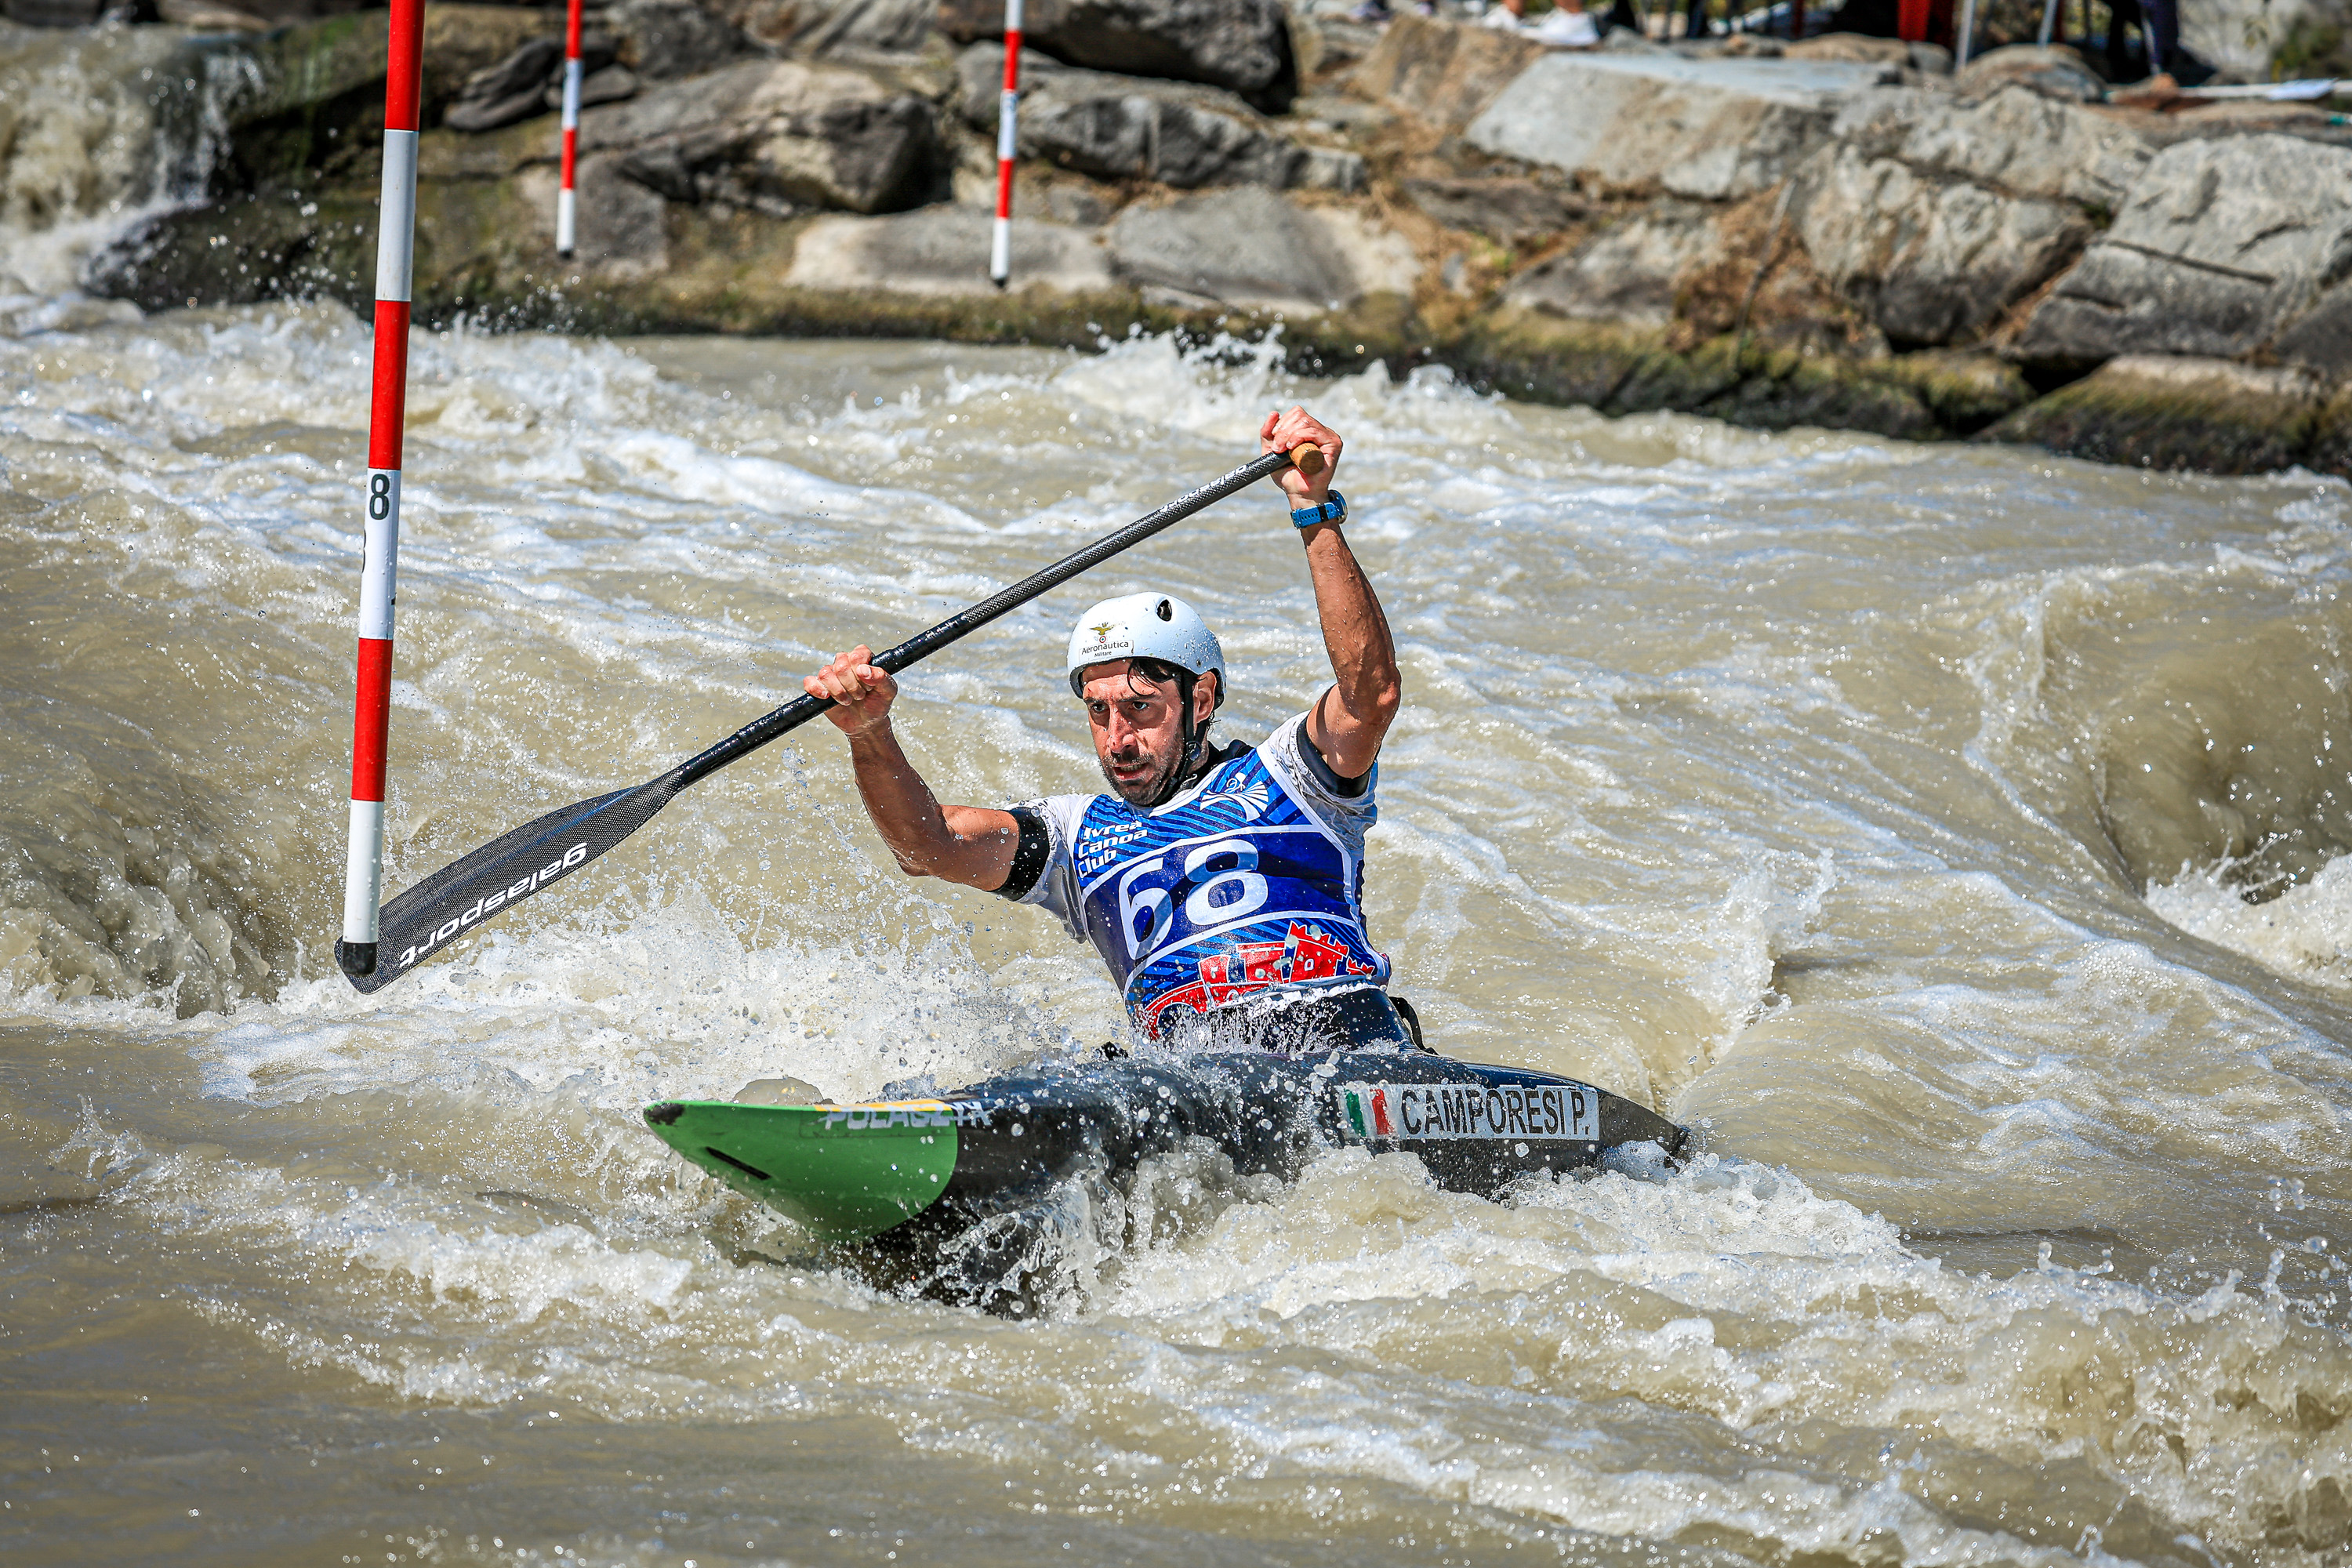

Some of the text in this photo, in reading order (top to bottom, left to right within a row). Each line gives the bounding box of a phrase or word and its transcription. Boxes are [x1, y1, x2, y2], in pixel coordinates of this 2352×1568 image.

[369, 474, 390, 521] 8
[1081, 641, 1129, 655] Aeronautica
[1078, 829, 1148, 858] Canoa
[1083, 820, 1142, 840] Ivrea
[1078, 848, 1117, 879] Club
[399, 842, 587, 968] galasport
[1119, 839, 1269, 960] 68
[1401, 1089, 1590, 1135] CAMPORESI P.
